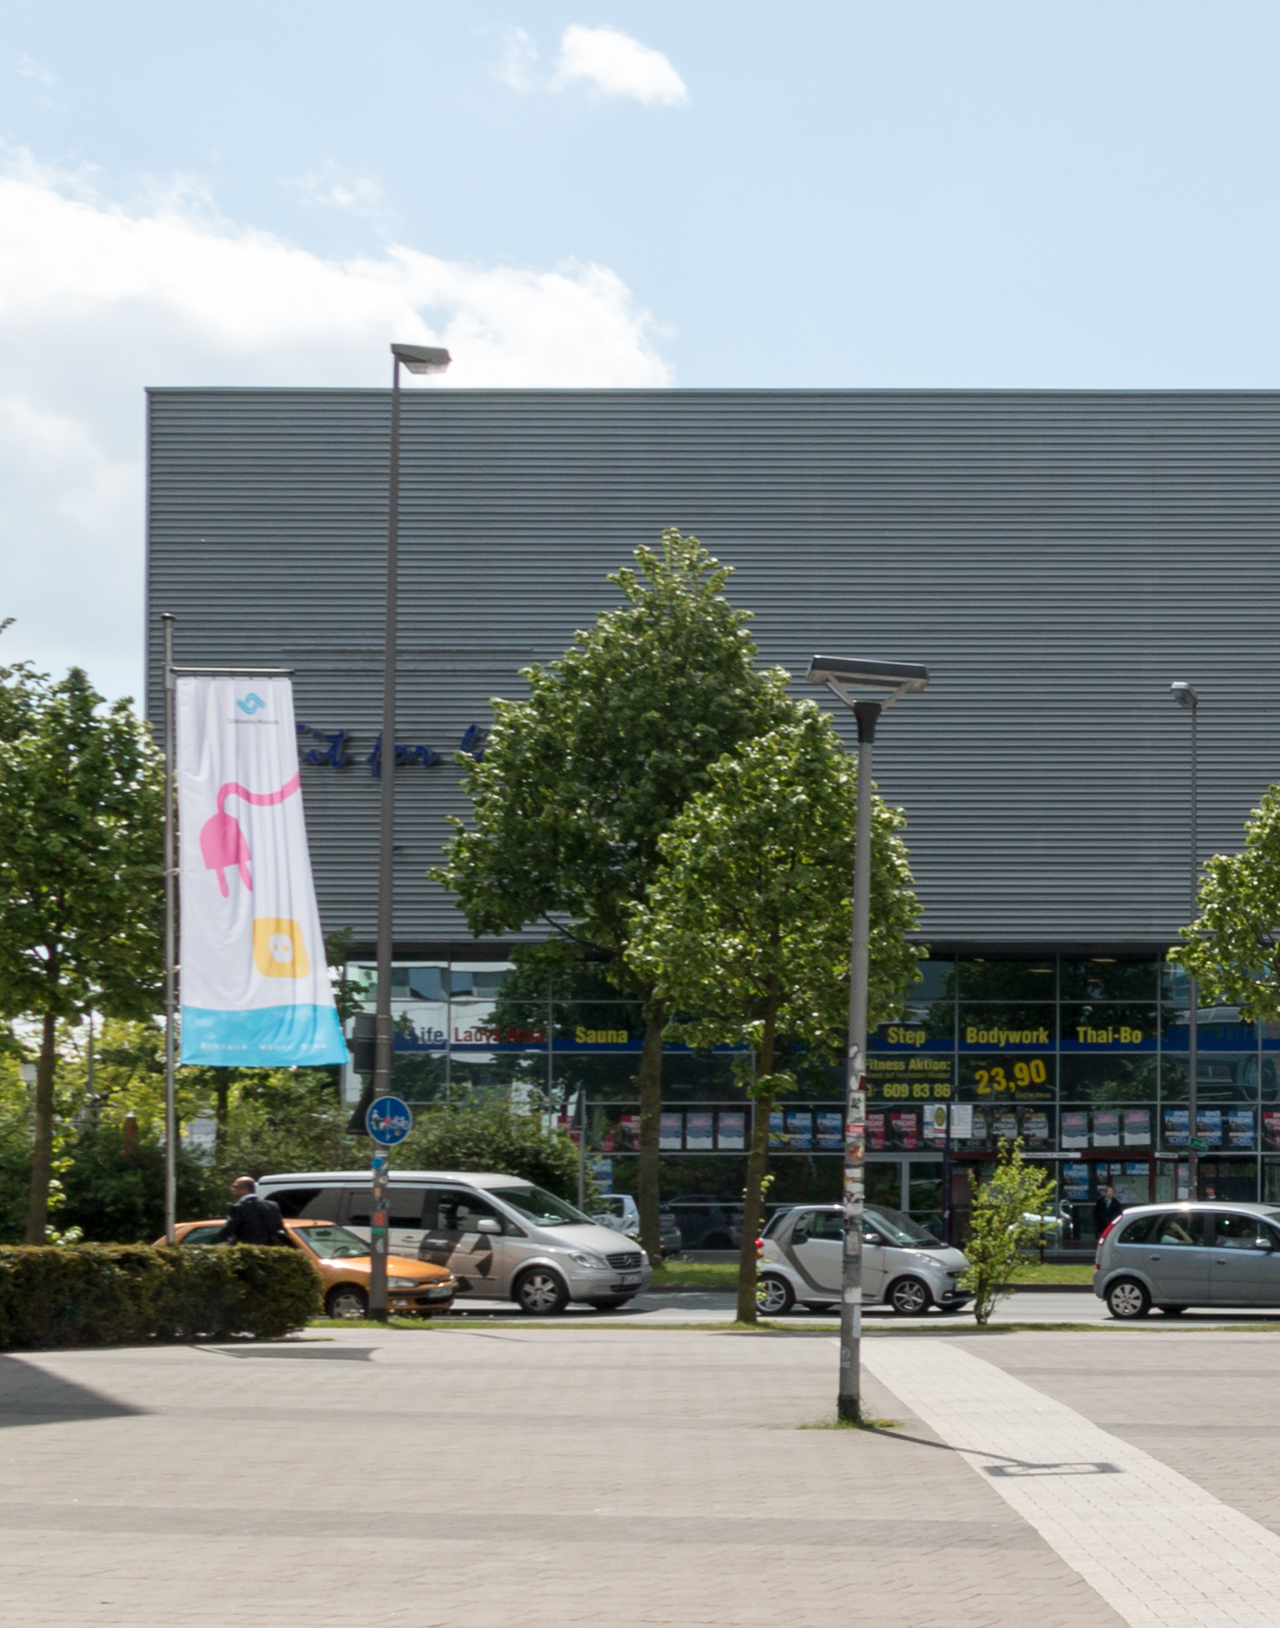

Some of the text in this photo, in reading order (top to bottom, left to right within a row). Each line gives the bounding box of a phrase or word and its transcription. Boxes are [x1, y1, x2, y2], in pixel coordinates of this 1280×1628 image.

[296, 724, 353, 767] it
[575, 1026, 629, 1044] Sauna
[887, 1026, 926, 1047] Step
[965, 1026, 1050, 1047] Bodywork
[1076, 1026, 1143, 1044] Thai-Bo
[866, 1058, 951, 1071] itness Aktion:
[974, 1059, 1047, 1095] 23,90
[883, 1083, 951, 1098] 609 83 86
